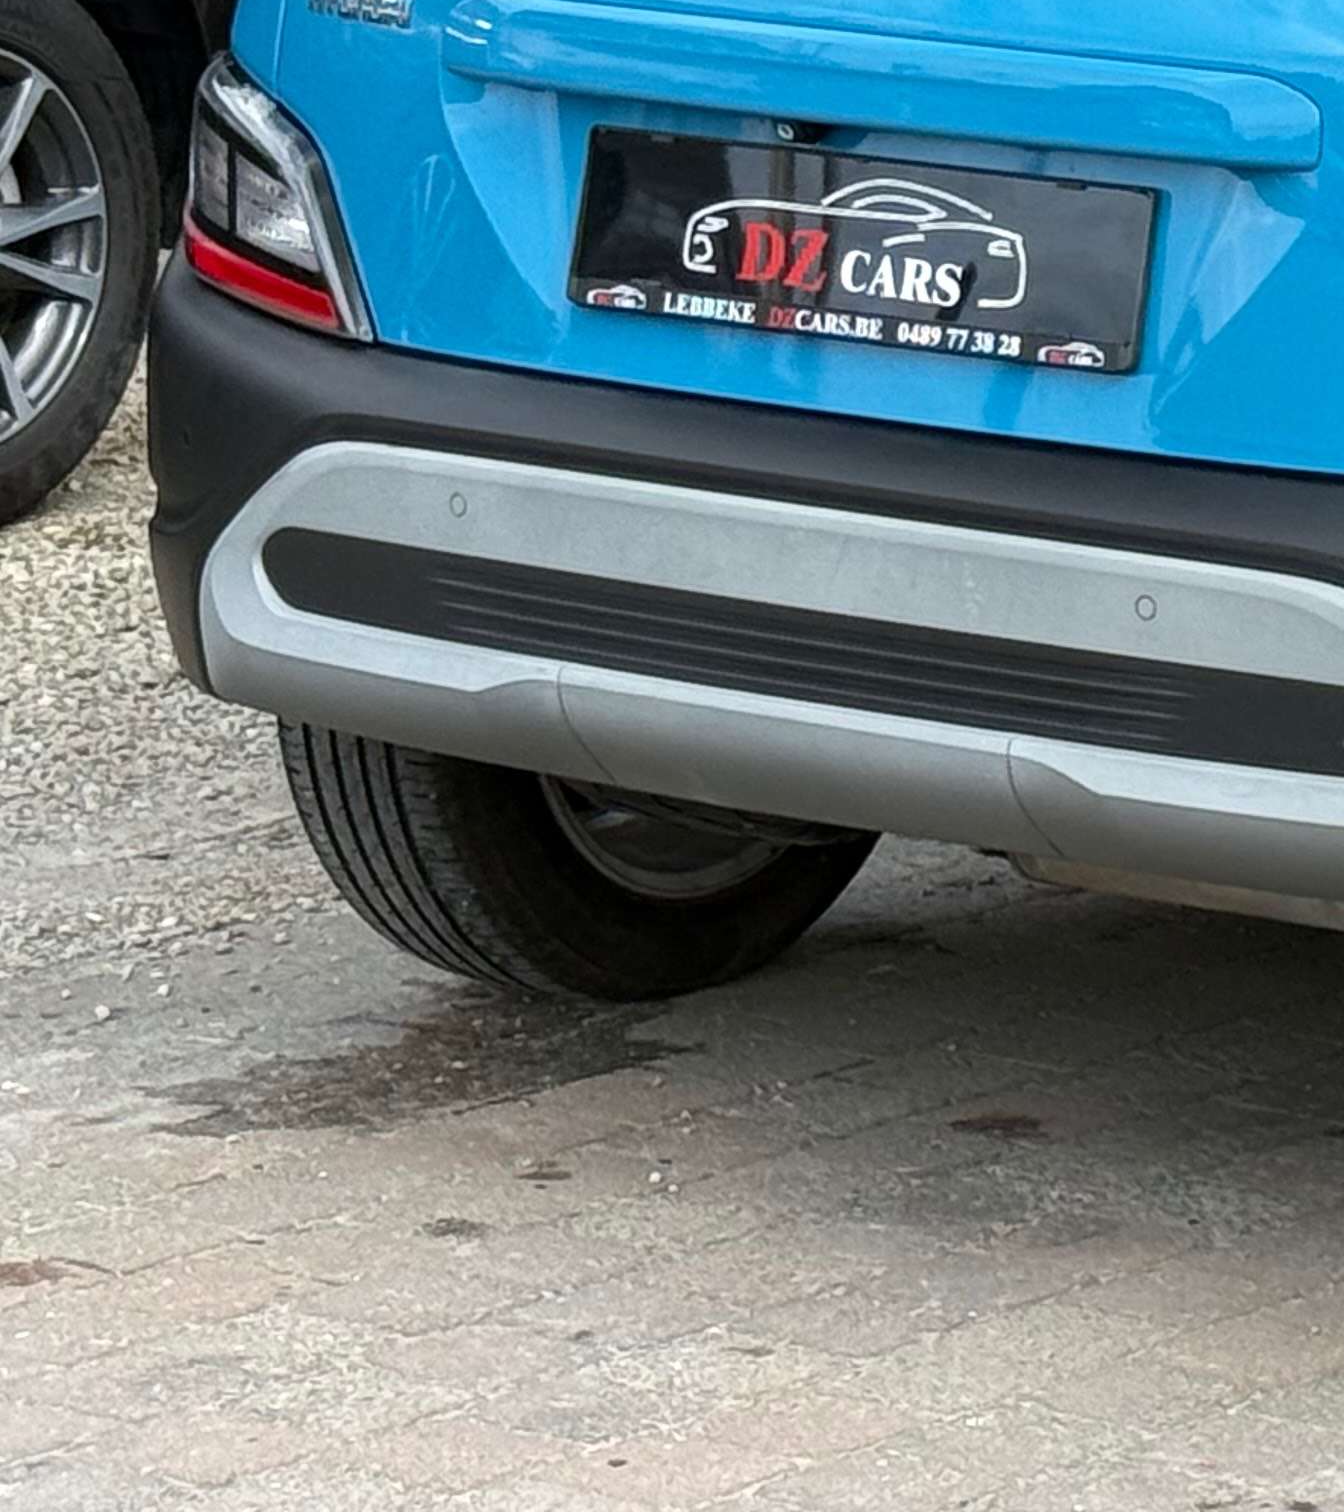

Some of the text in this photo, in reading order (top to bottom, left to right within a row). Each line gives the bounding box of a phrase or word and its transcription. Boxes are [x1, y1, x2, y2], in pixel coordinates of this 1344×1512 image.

[735, 222, 964, 308] DZ CARS
[663, 292, 756, 324] LEBBEKE
[767, 306, 883, 339] DZCARS.BE
[897, 322, 942, 346] 0489
[946, 326, 968, 350] 77
[997, 334, 1022, 358] 28
